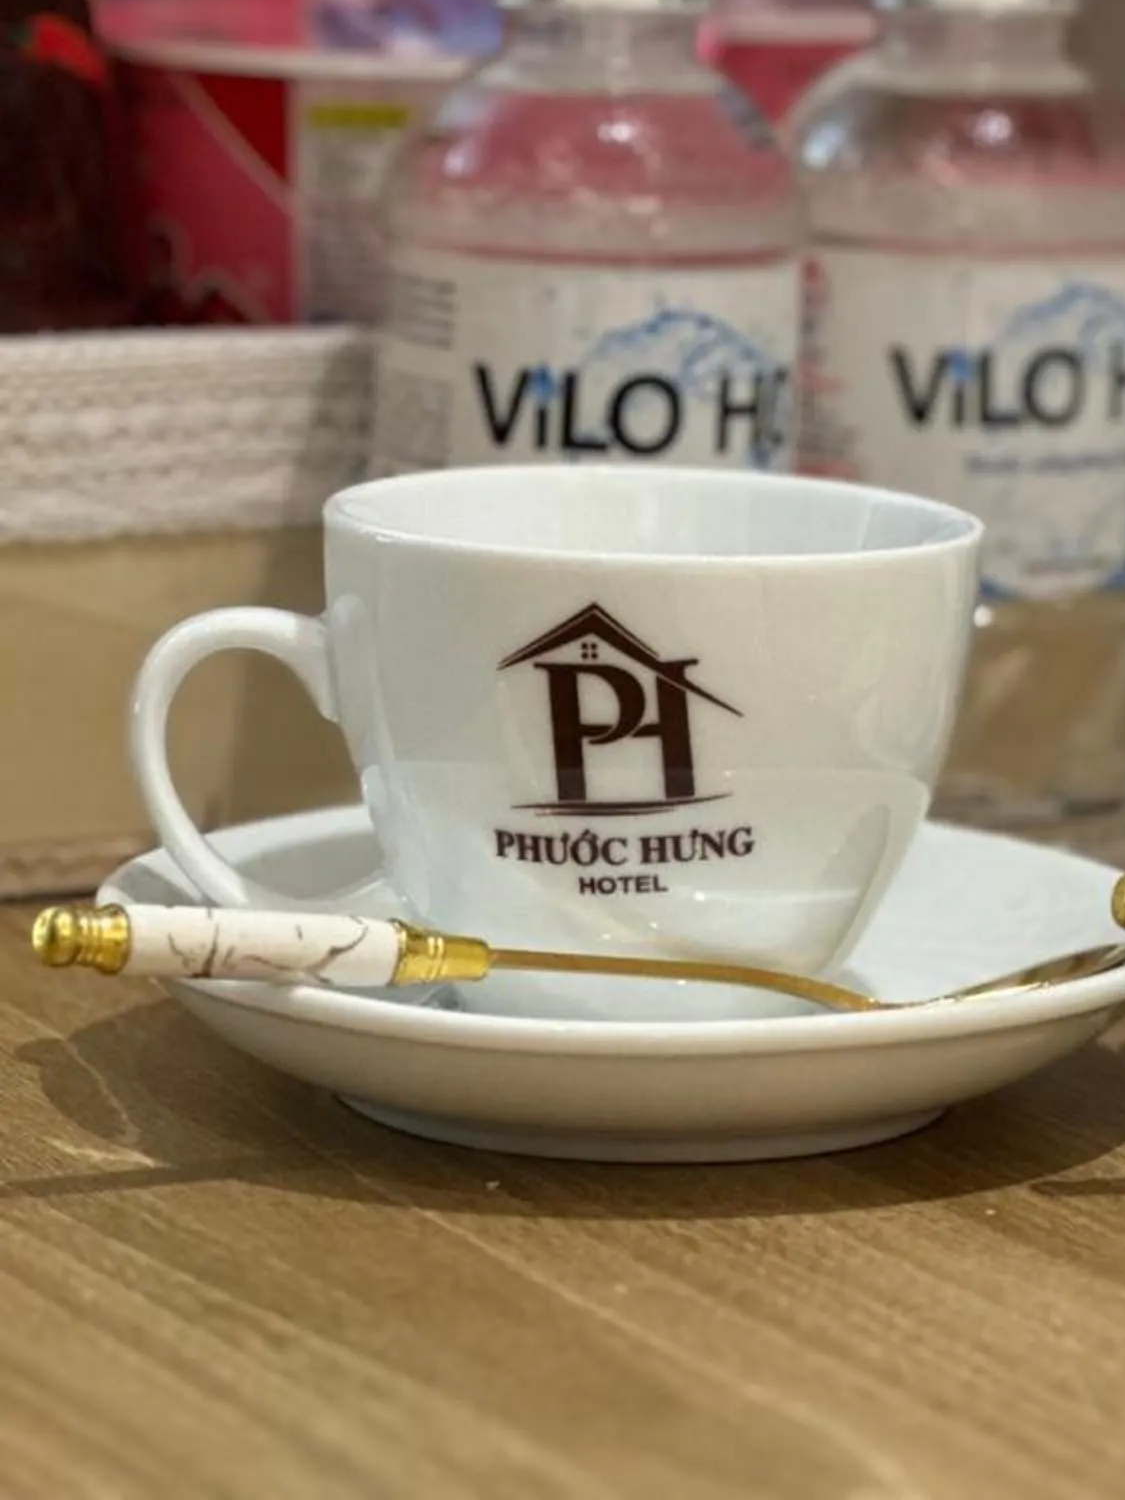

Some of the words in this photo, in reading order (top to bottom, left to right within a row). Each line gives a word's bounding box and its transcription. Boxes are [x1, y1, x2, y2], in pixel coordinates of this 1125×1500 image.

[494, 828, 629, 867] PHƯỚC
[639, 826, 756, 866] HƯNG
[578, 874, 669, 895] HOTEL
